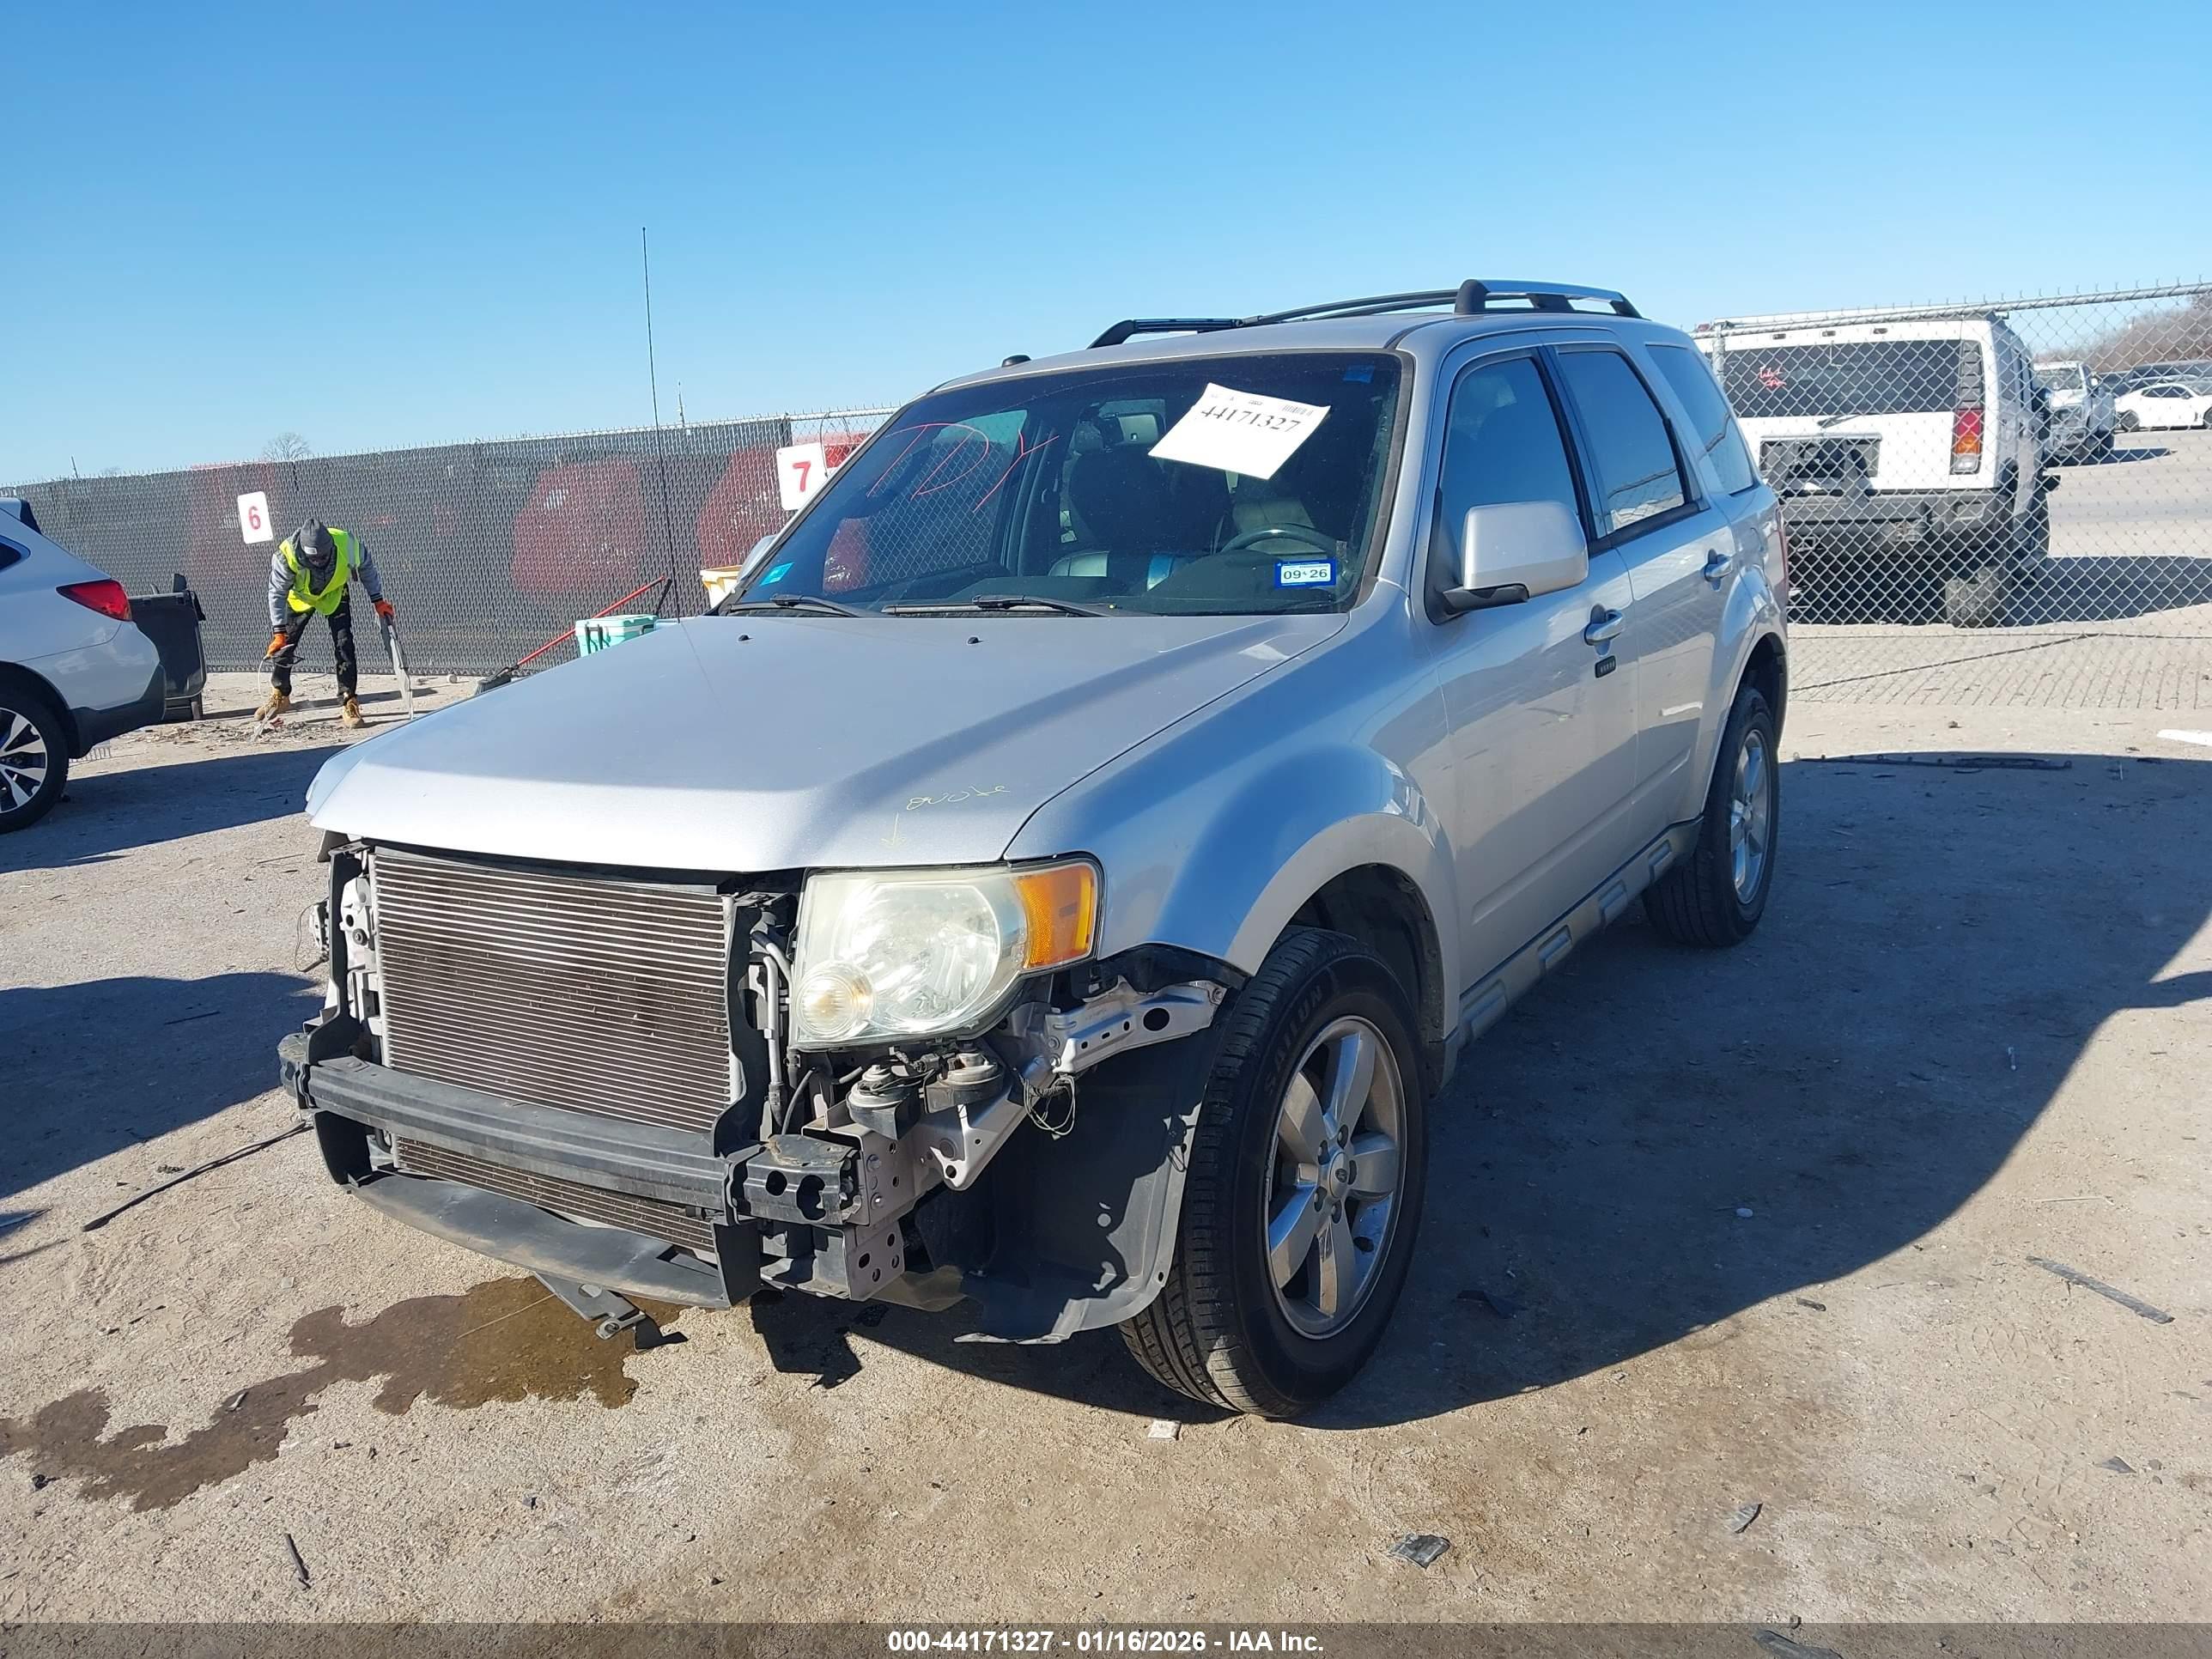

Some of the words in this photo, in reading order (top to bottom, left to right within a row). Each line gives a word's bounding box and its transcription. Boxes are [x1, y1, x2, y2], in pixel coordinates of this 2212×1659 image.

[1201, 405, 1302, 433] 44171327
[793, 460, 811, 493] 7
[248, 505, 261, 530] 6
[1283, 570, 1302, 580] 09
[1310, 568, 1328, 579] 26
